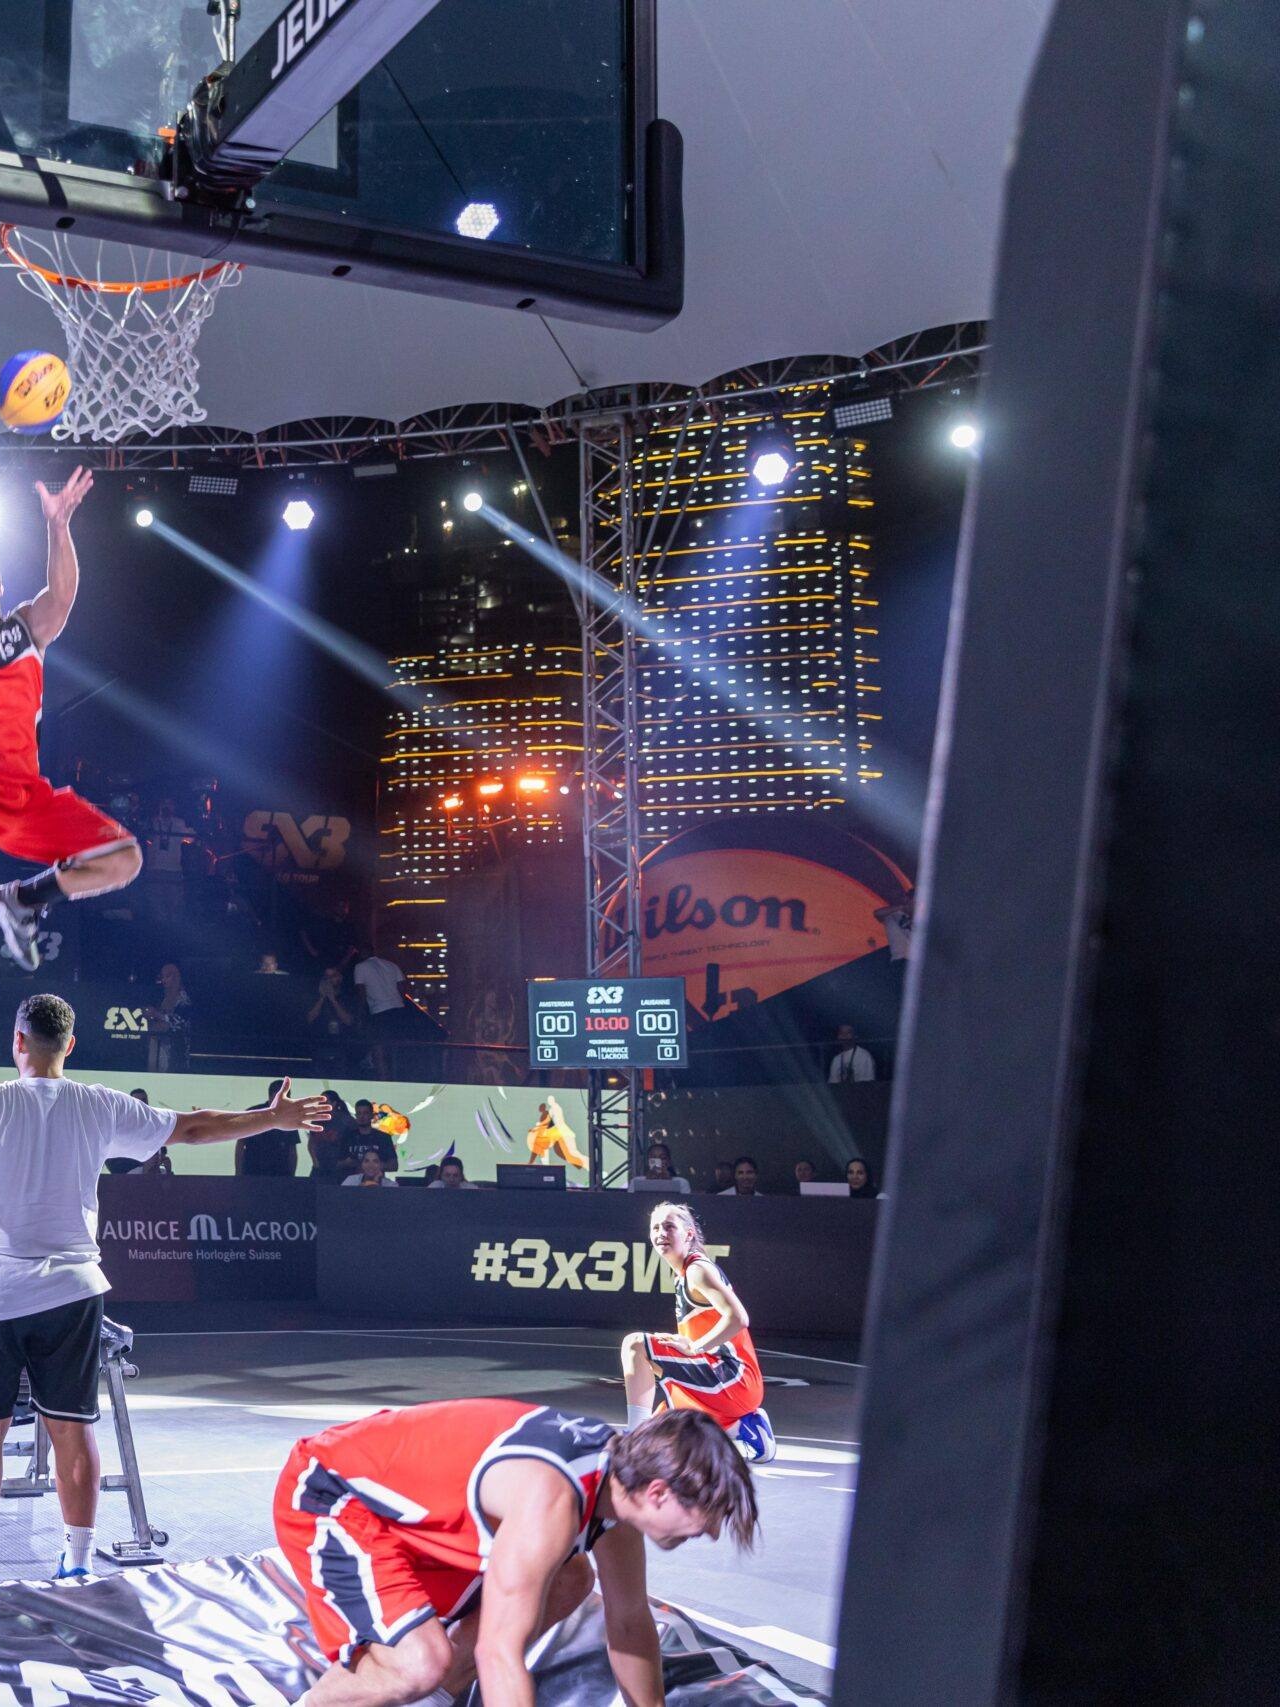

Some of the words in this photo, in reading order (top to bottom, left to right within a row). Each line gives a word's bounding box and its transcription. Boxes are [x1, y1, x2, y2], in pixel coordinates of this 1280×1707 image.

[543, 1015, 570, 1033] 00
[585, 1017, 630, 1031] 10:00
[643, 1013, 672, 1031] 00
[543, 1048, 552, 1059] 0
[664, 1047, 672, 1058] 0
[96, 1220, 180, 1240] AURICE
[128, 1248, 193, 1260] Manufacture
[196, 1248, 246, 1262] Horlogère
[249, 1249, 282, 1260] Suisse
